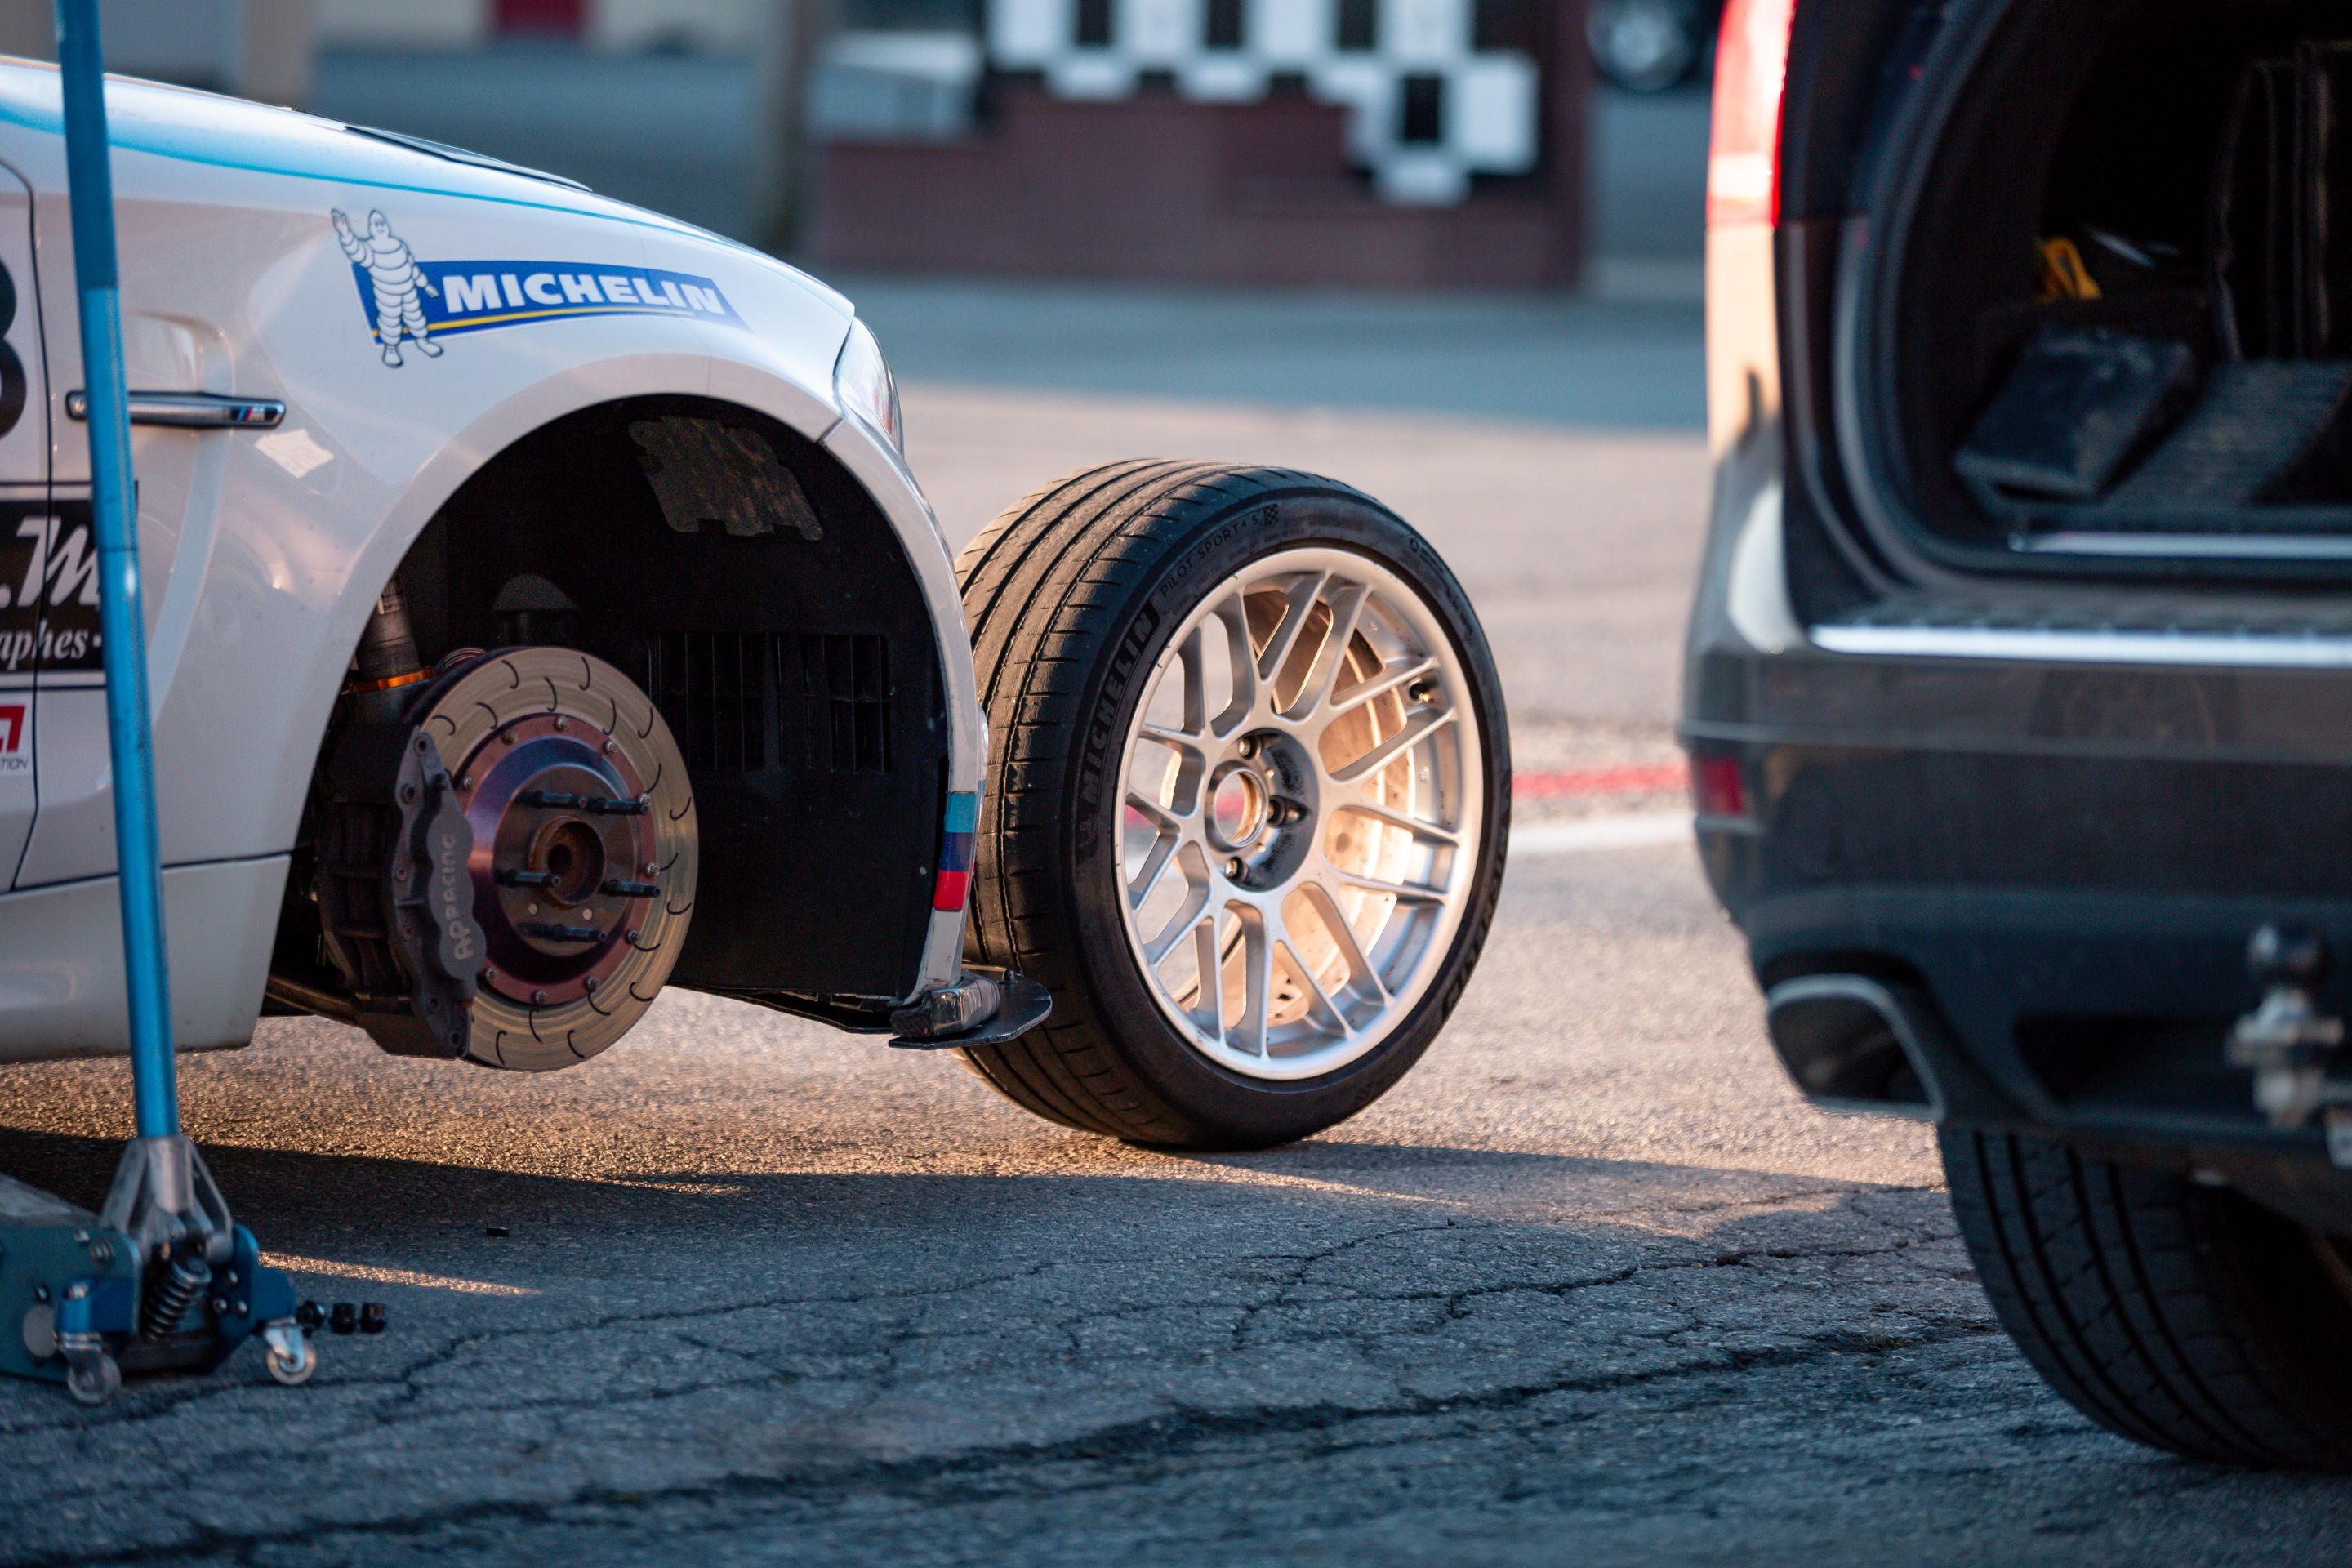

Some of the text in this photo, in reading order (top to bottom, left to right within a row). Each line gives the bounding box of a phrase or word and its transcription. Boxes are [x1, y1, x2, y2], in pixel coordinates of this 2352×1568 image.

[442, 273, 728, 315] MICHELIN
[1160, 559, 1193, 598] PILOT
[1197, 523, 1240, 560] SPORT
[1080, 614, 1156, 804] MICHELIN
